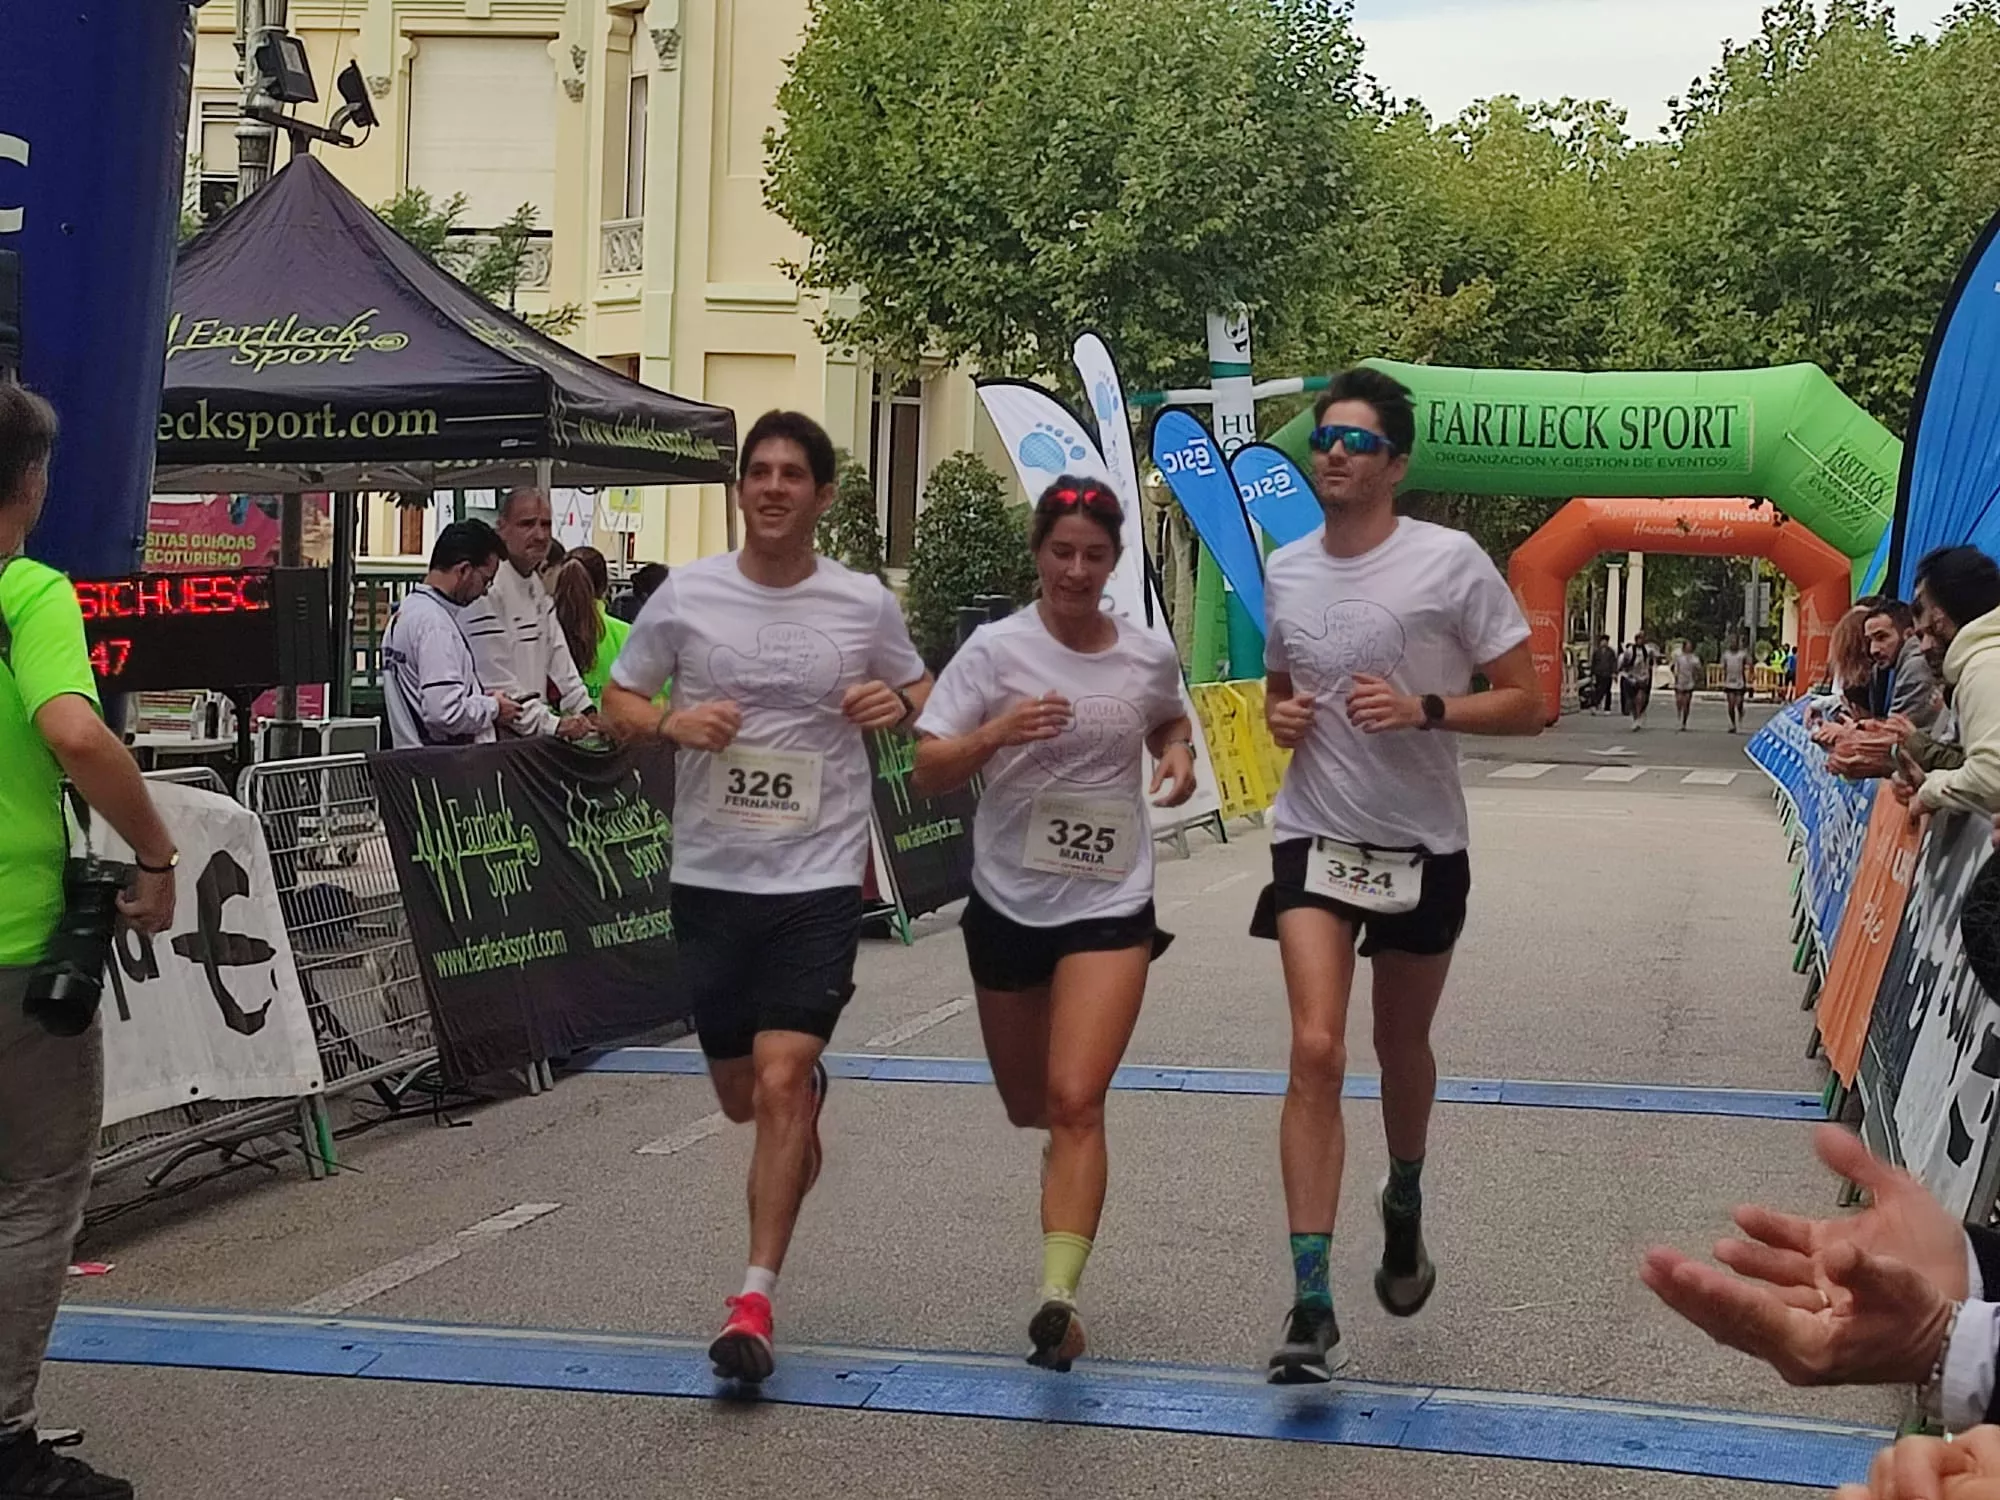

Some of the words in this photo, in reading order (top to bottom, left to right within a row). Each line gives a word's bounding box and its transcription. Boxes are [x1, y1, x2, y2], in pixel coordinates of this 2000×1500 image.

[1426, 400, 1610, 449] FARTLECK
[1619, 404, 1739, 450] SPORT
[1632, 457, 1653, 468] DE
[1657, 457, 1728, 467] EVENTOS
[1719, 508, 1769, 522] Huesca
[191, 534, 257, 551] GUIADAS
[144, 548, 241, 567] ECOTURISMO
[728, 768, 792, 799] 326
[1047, 819, 1116, 853] 325
[1059, 847, 1105, 864] MARIA
[483, 850, 532, 917] Sport
[1326, 859, 1393, 889] 324
